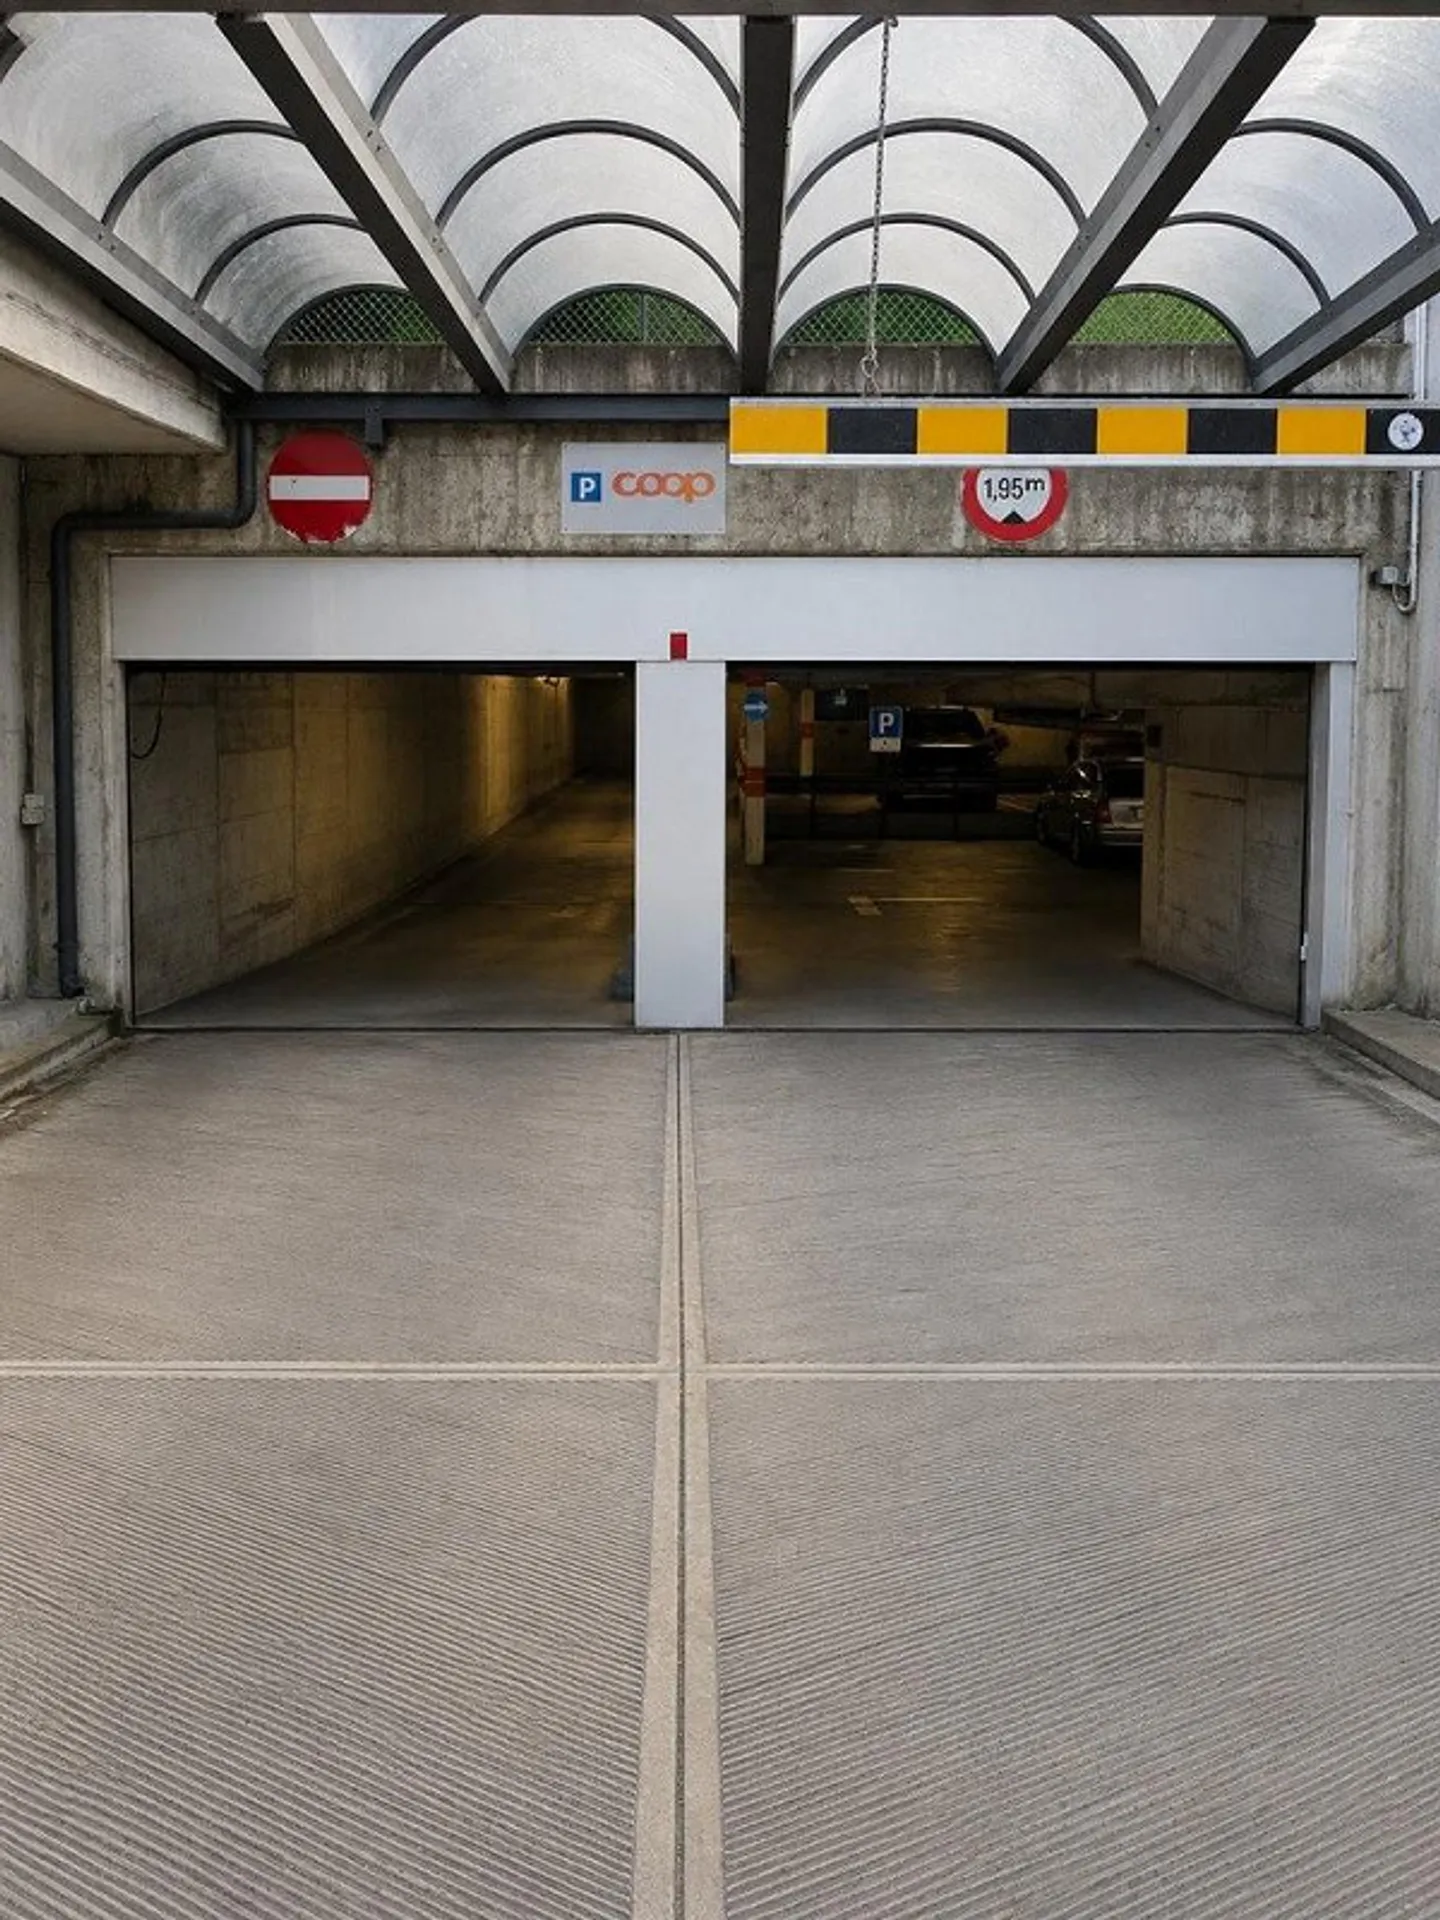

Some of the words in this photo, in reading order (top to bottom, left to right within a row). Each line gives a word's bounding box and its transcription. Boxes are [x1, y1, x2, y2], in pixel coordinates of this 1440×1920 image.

[579, 477, 596, 500] P
[612, 472, 716, 503] coop
[984, 477, 1045, 501] 1,95m
[879, 712, 895, 734] P
